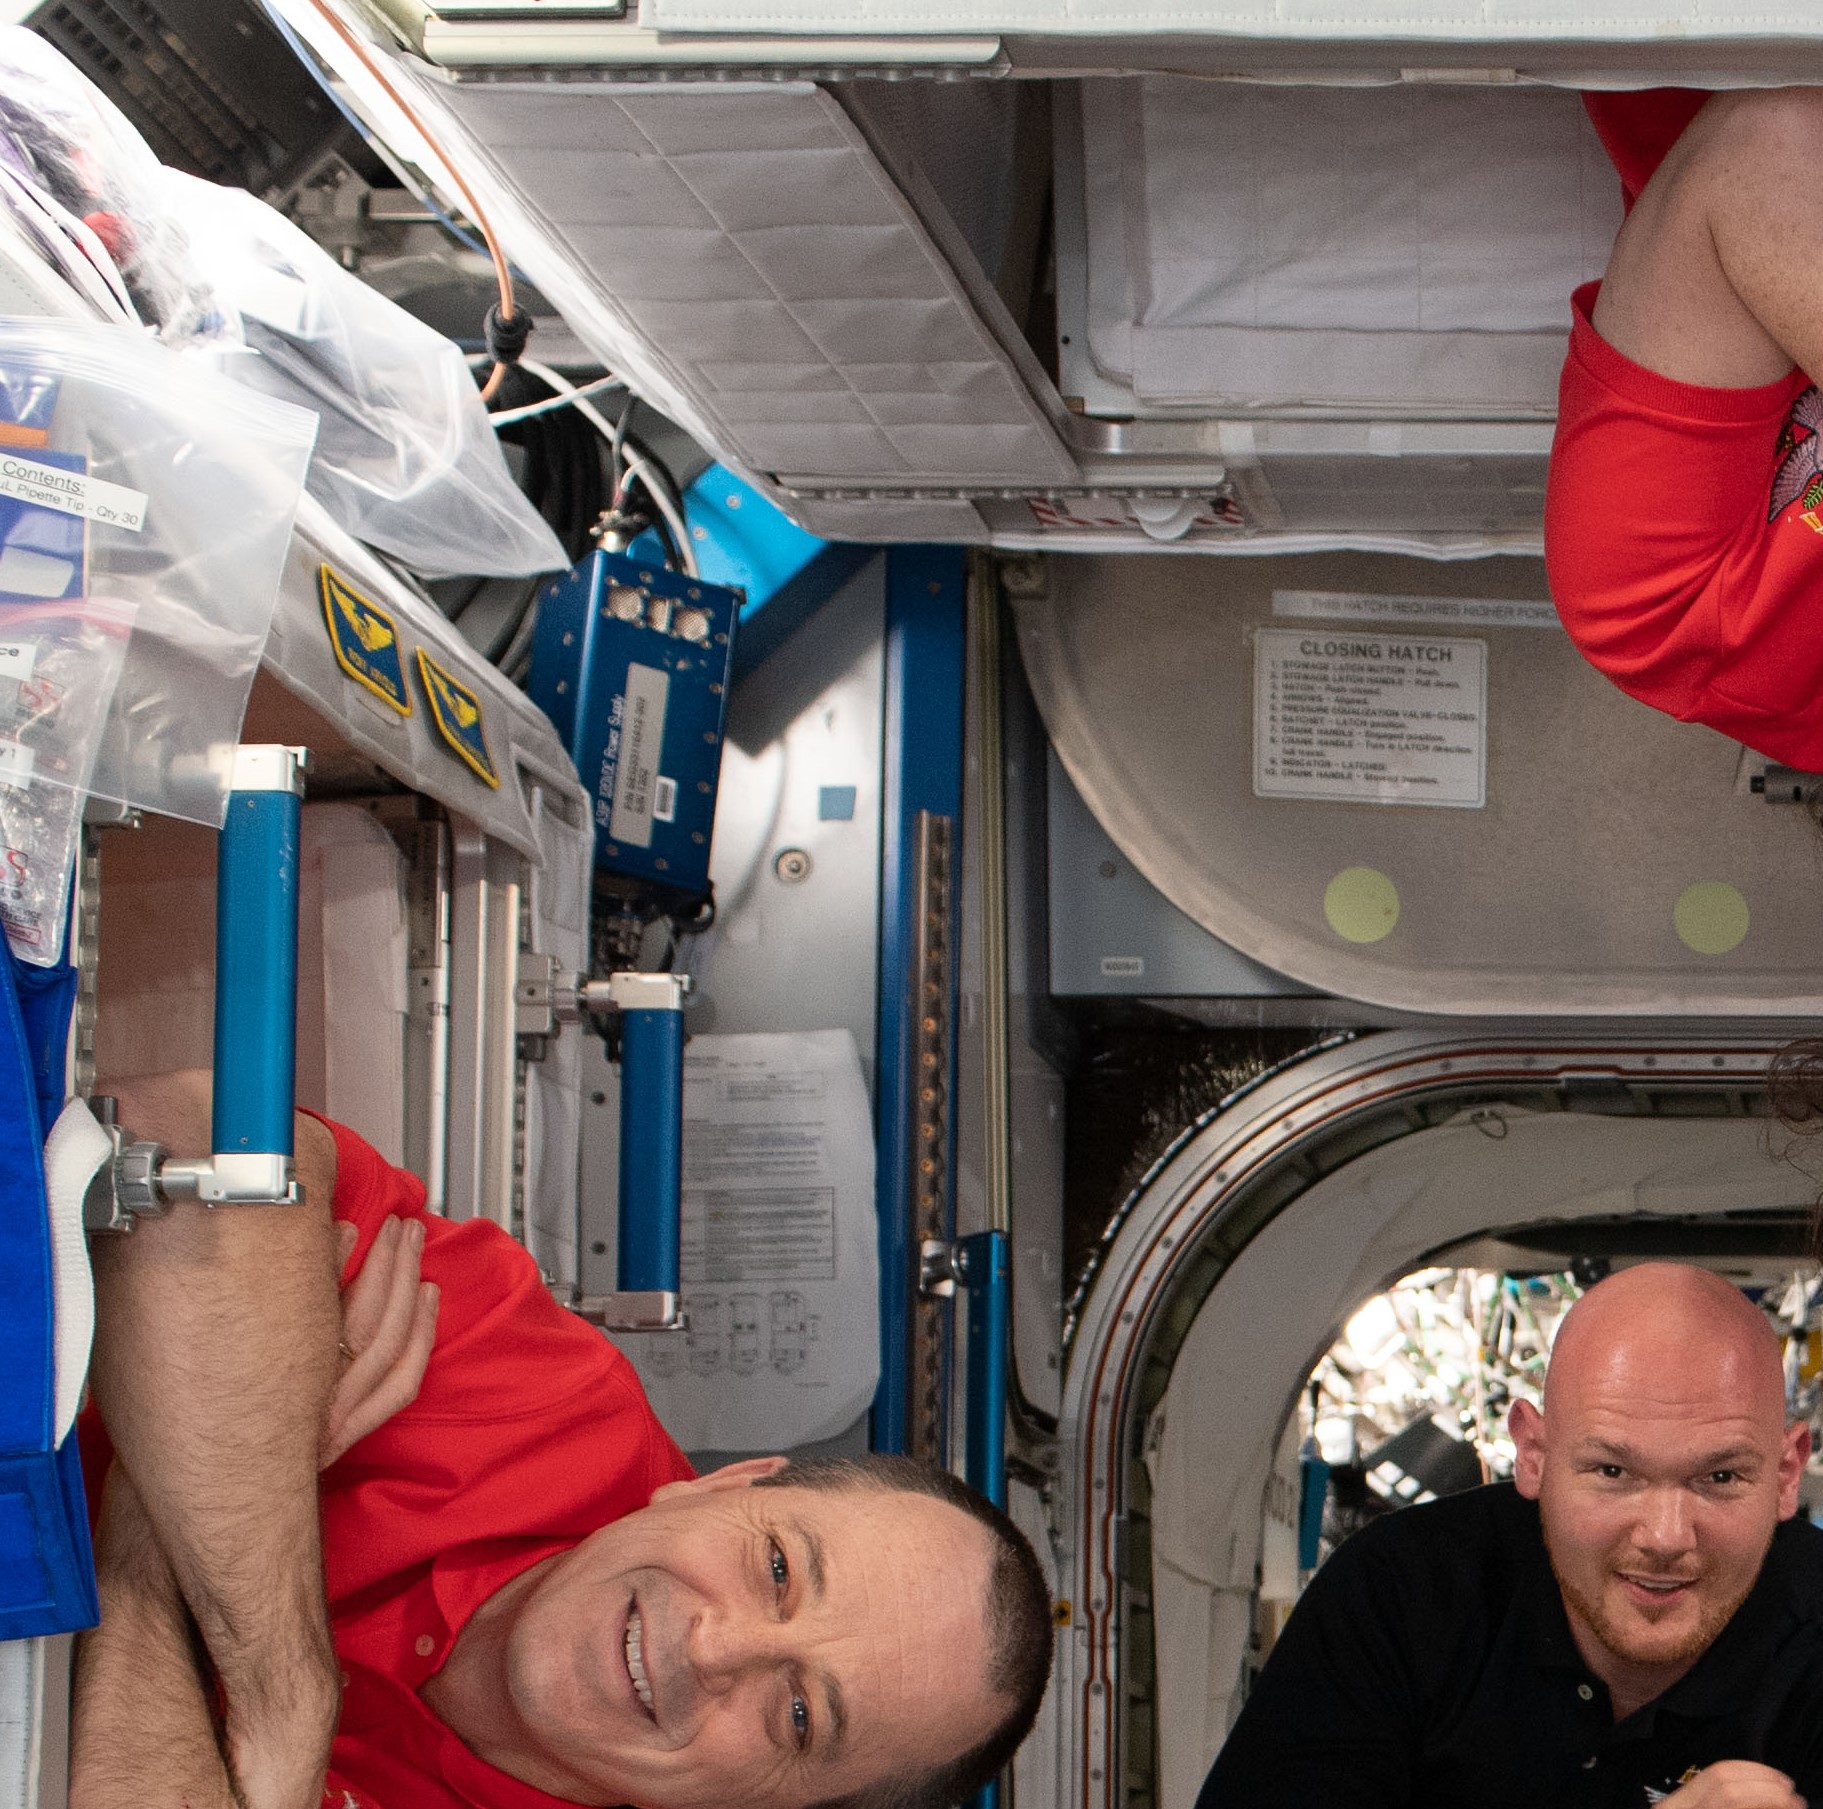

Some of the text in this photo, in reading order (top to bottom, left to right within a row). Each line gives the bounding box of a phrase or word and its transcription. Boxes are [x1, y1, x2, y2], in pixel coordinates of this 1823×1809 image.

[1, 459, 87, 494] Contents:
[15, 483, 61, 504] Pipette
[66, 496, 84, 512] Tip
[95, 505, 117, 521] Qty
[121, 512, 138, 525] 30
[1300, 640, 1452, 663] CLOSING HATCH
